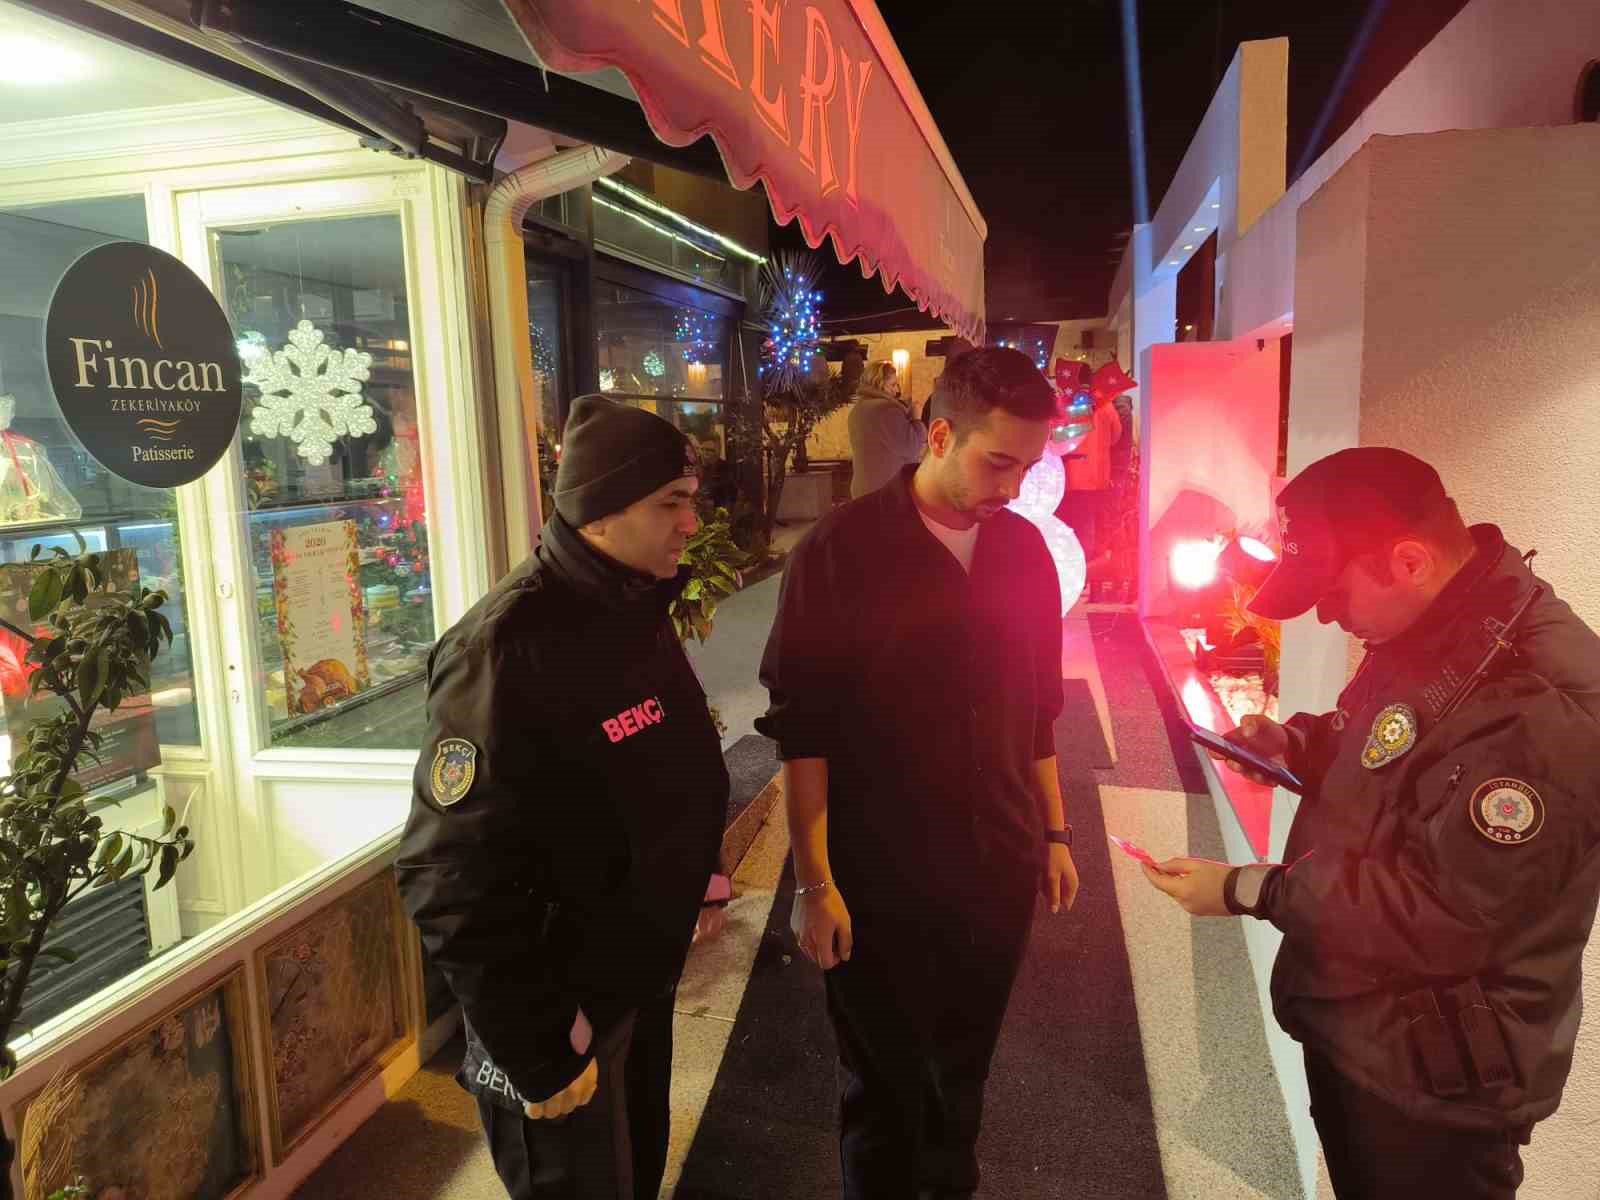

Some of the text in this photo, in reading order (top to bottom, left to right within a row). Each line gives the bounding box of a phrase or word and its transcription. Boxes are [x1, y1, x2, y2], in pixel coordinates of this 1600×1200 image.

[68, 336, 227, 392] Fincan
[111, 397, 201, 412] ZEKERİYAKÖY
[132, 444, 194, 462] Patisserie
